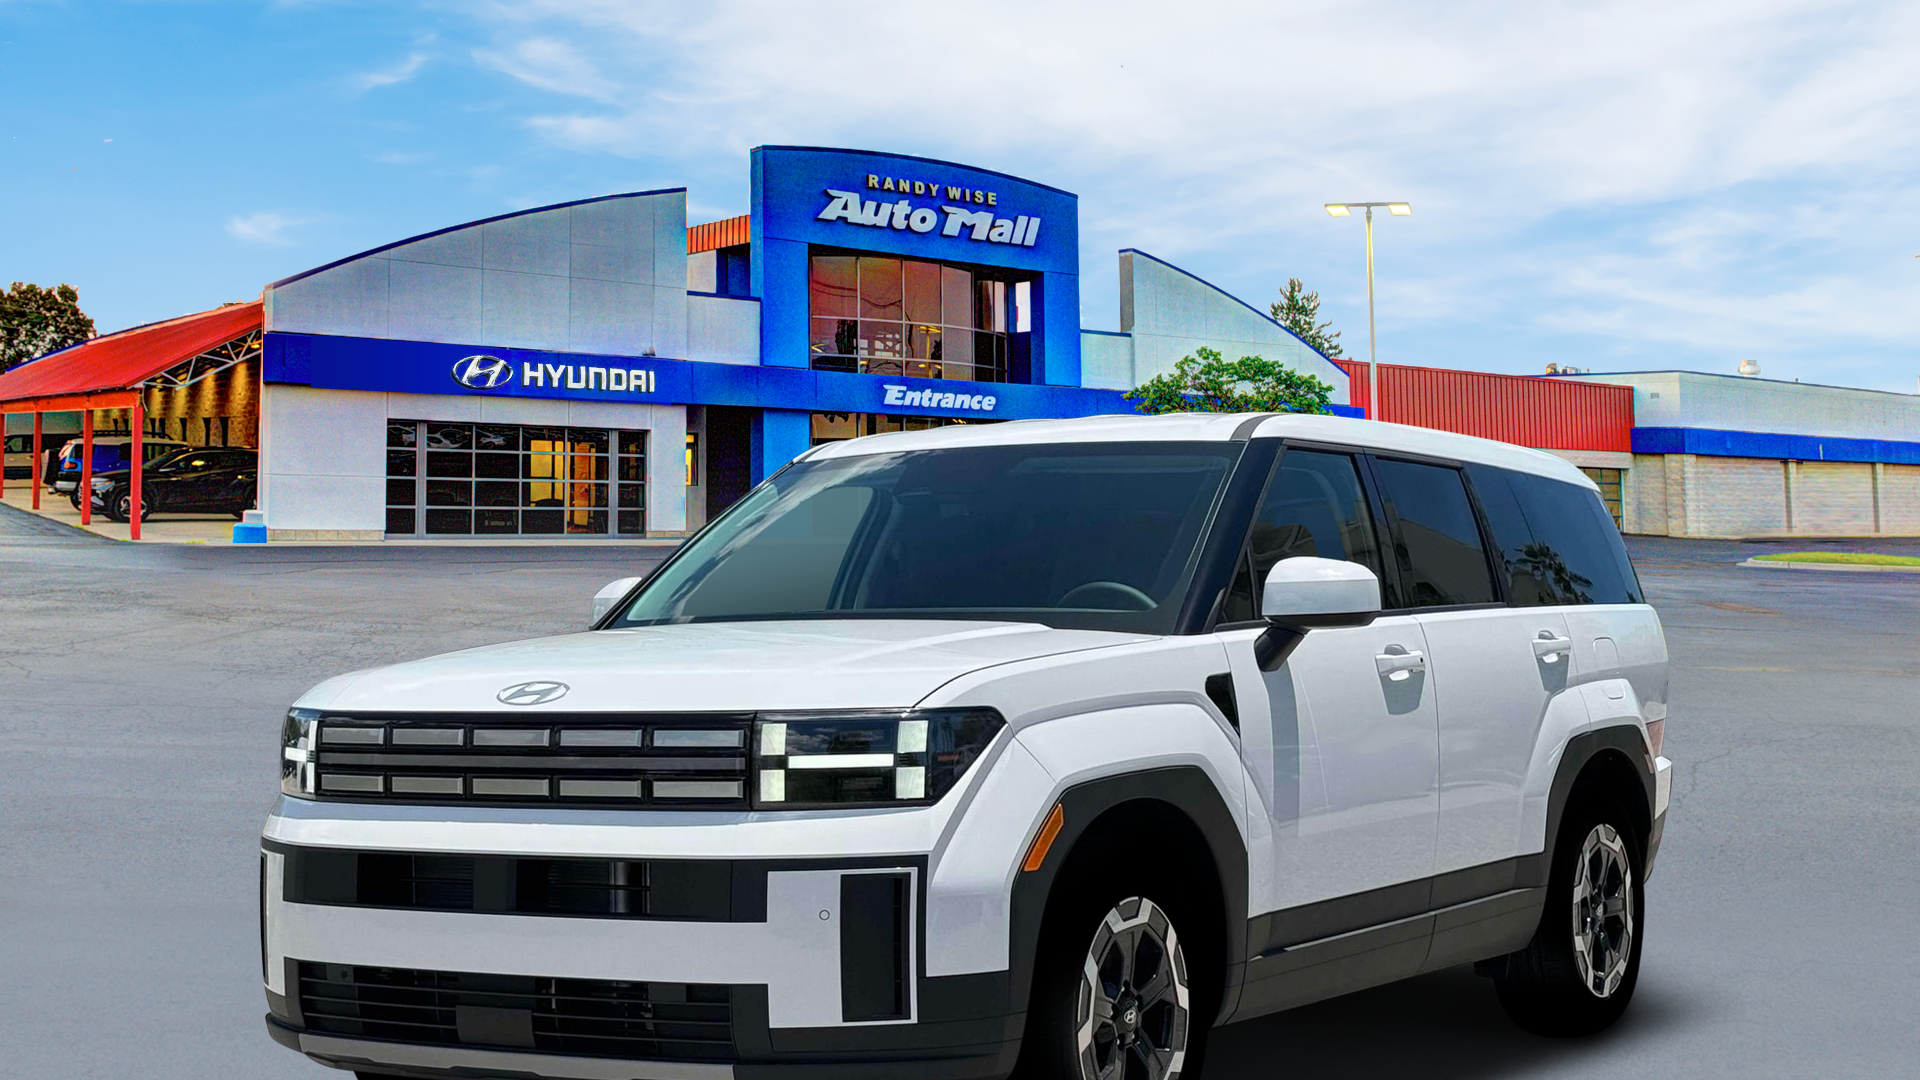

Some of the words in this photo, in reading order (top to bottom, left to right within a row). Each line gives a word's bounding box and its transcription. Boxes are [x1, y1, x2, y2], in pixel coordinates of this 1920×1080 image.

[867, 173, 939, 196] RANDY
[946, 186, 998, 206] WISE
[816, 188, 938, 233] Auto
[940, 204, 1041, 247] Mall
[522, 361, 655, 393] HYUNDAI
[883, 384, 996, 411] Entrance
